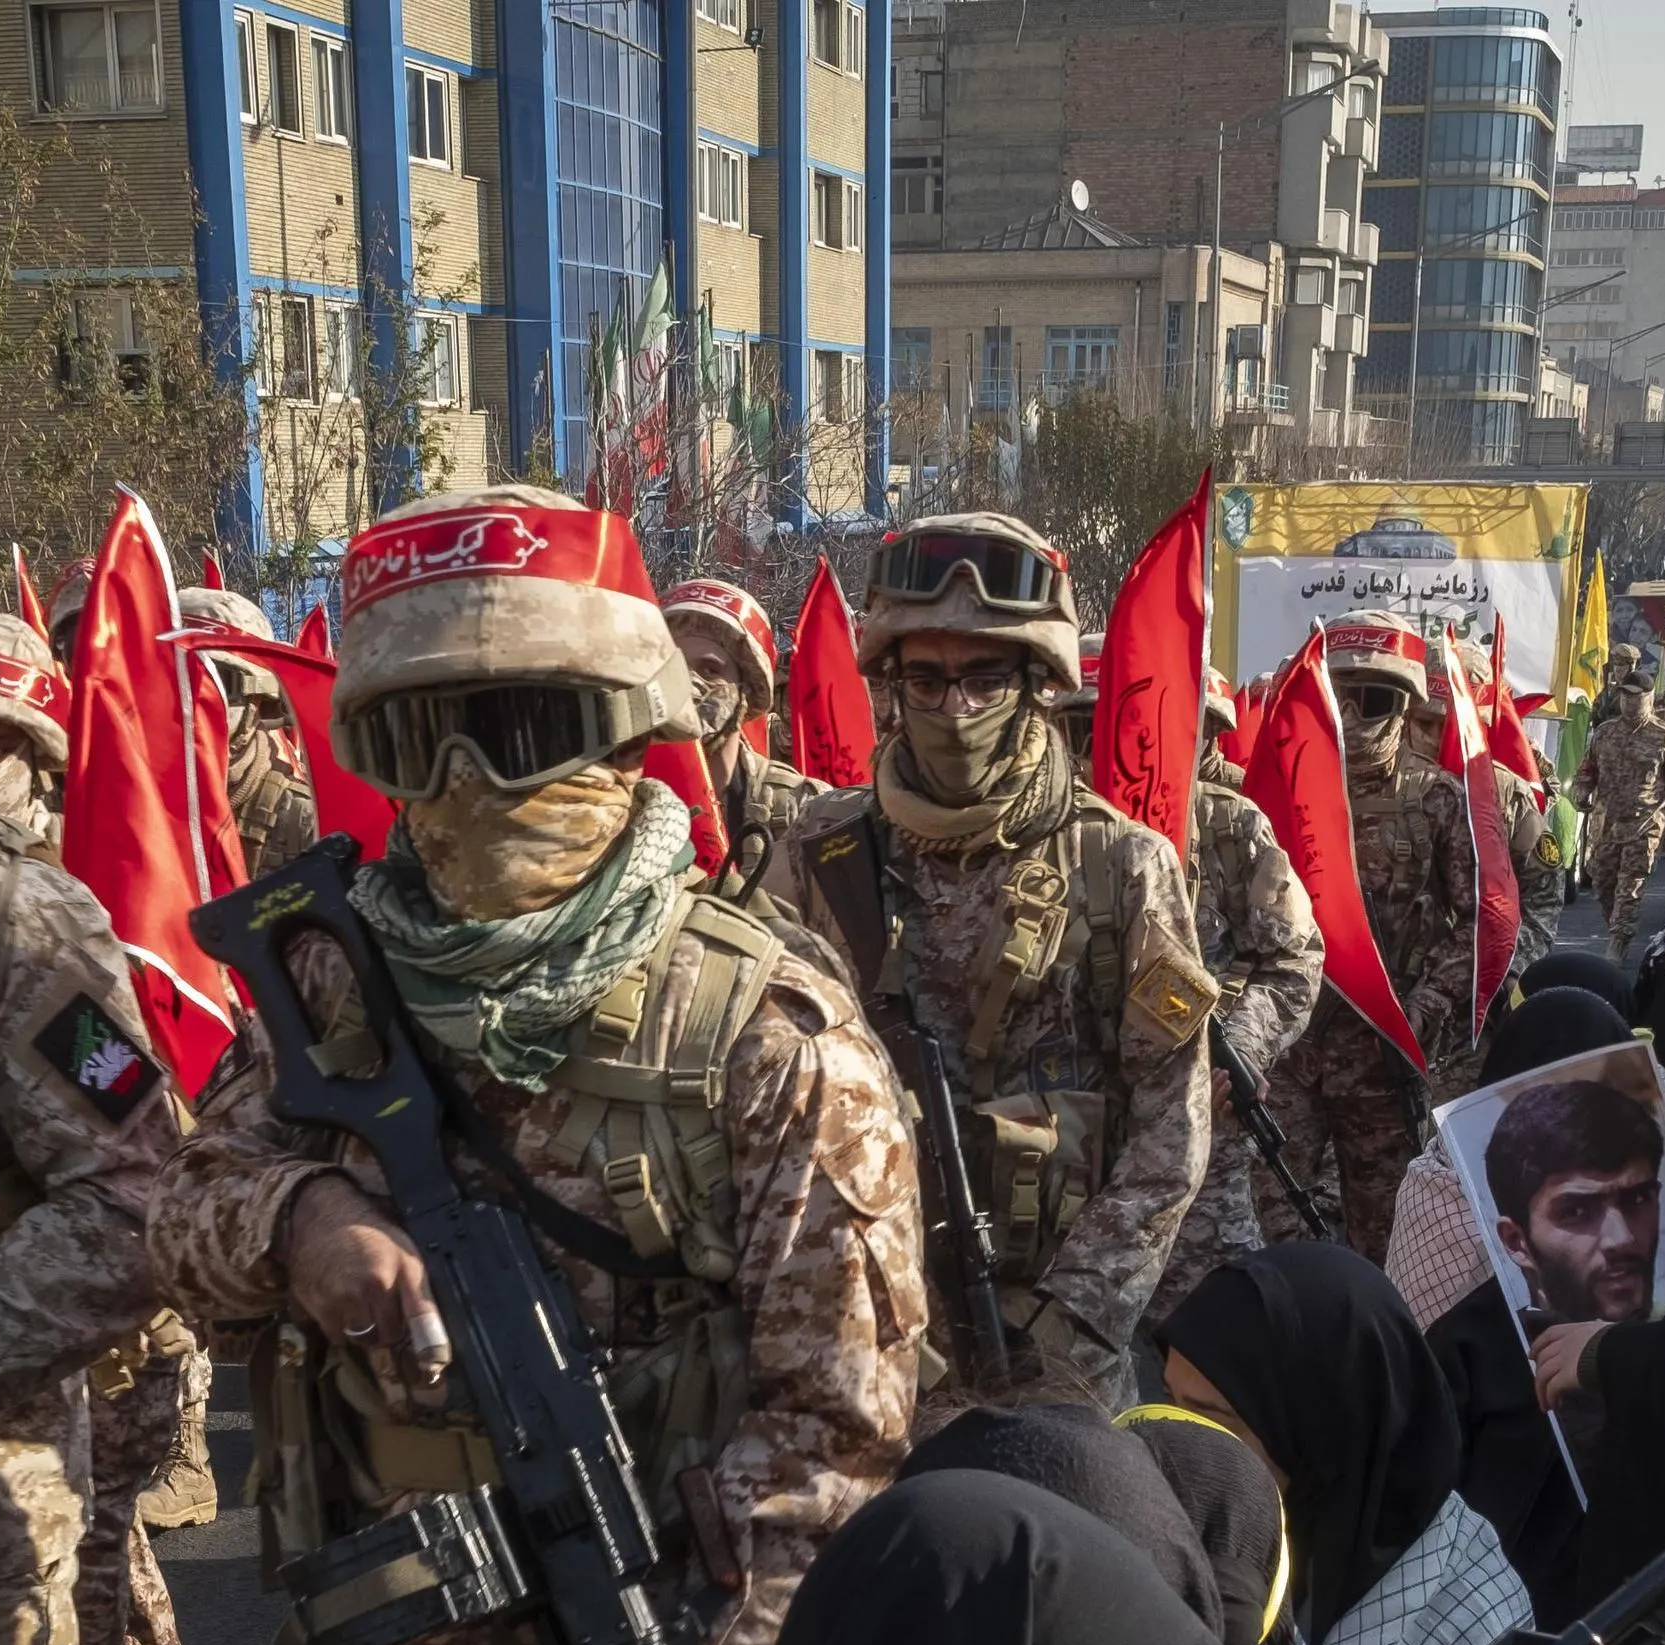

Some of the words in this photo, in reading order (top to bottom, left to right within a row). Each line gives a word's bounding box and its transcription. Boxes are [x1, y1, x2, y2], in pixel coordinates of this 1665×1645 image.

[409, 541, 423, 577] یا
[425, 518, 496, 569] لبیک
[1301, 570, 1346, 599] قدس
[1353, 571, 1412, 600] راهیان
[1420, 572, 1489, 604] رزمایش
